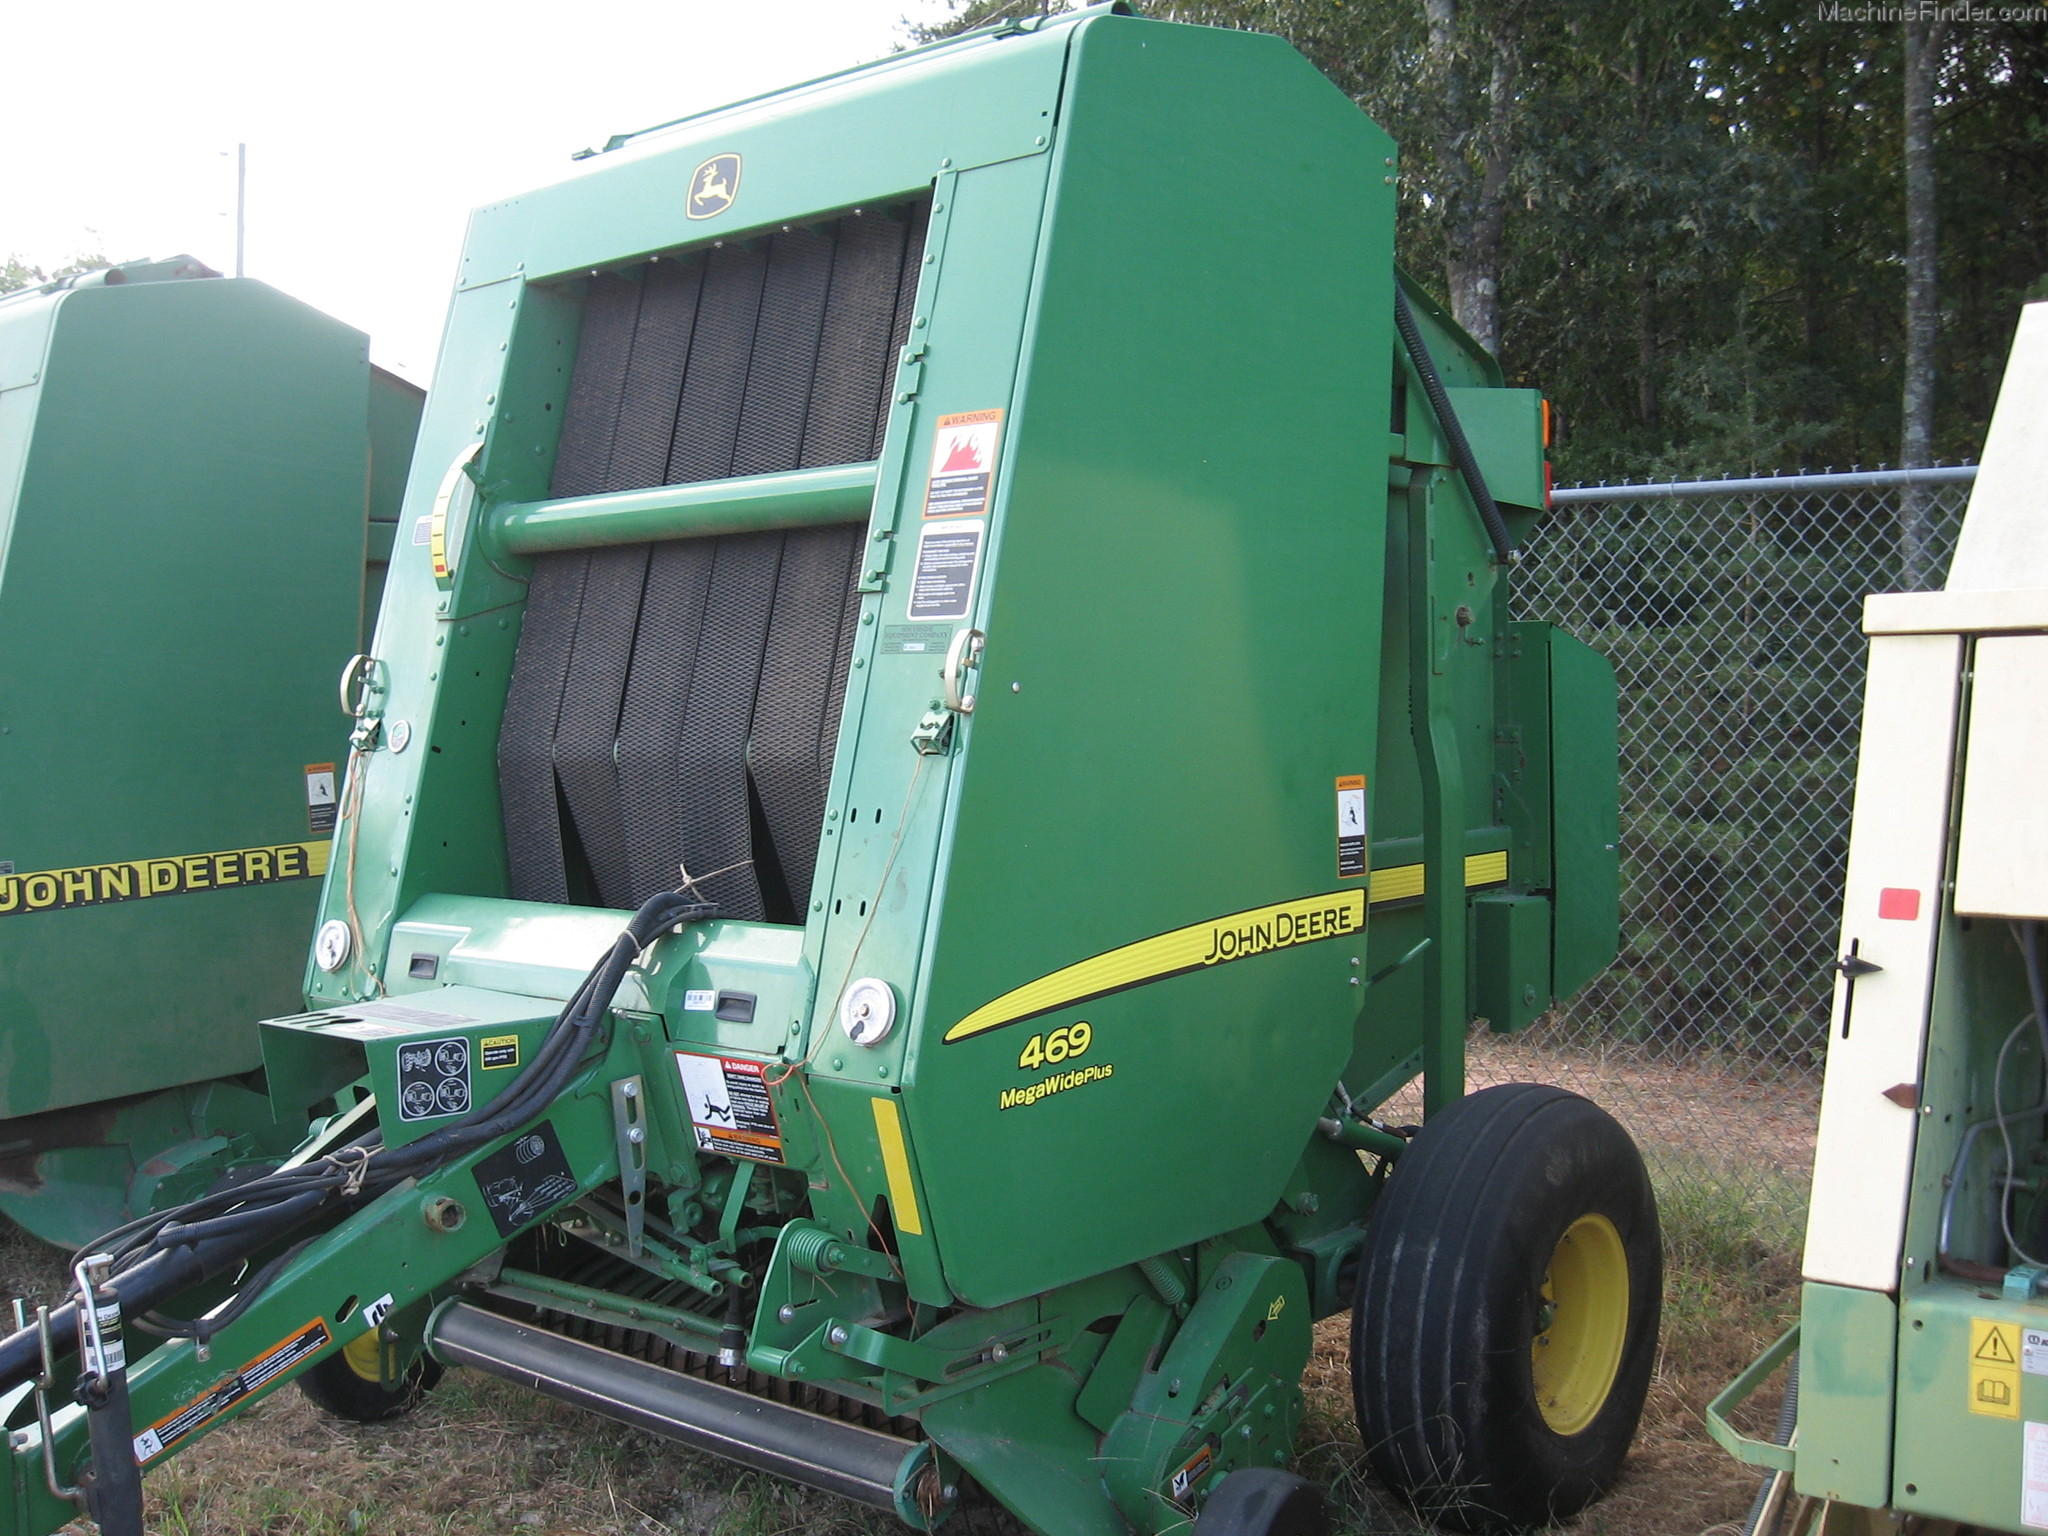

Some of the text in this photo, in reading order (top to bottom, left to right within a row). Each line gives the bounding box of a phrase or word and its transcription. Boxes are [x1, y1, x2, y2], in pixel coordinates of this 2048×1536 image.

[951, 411, 996, 425] WARNING
[0, 847, 301, 912] JOHN DEERE
[1204, 906, 1352, 961] JOHN DEERE
[731, 1062, 760, 1074] DANGER
[1019, 1021, 1092, 1069] 469
[1000, 1064, 1113, 1110] MegaWidePlus
